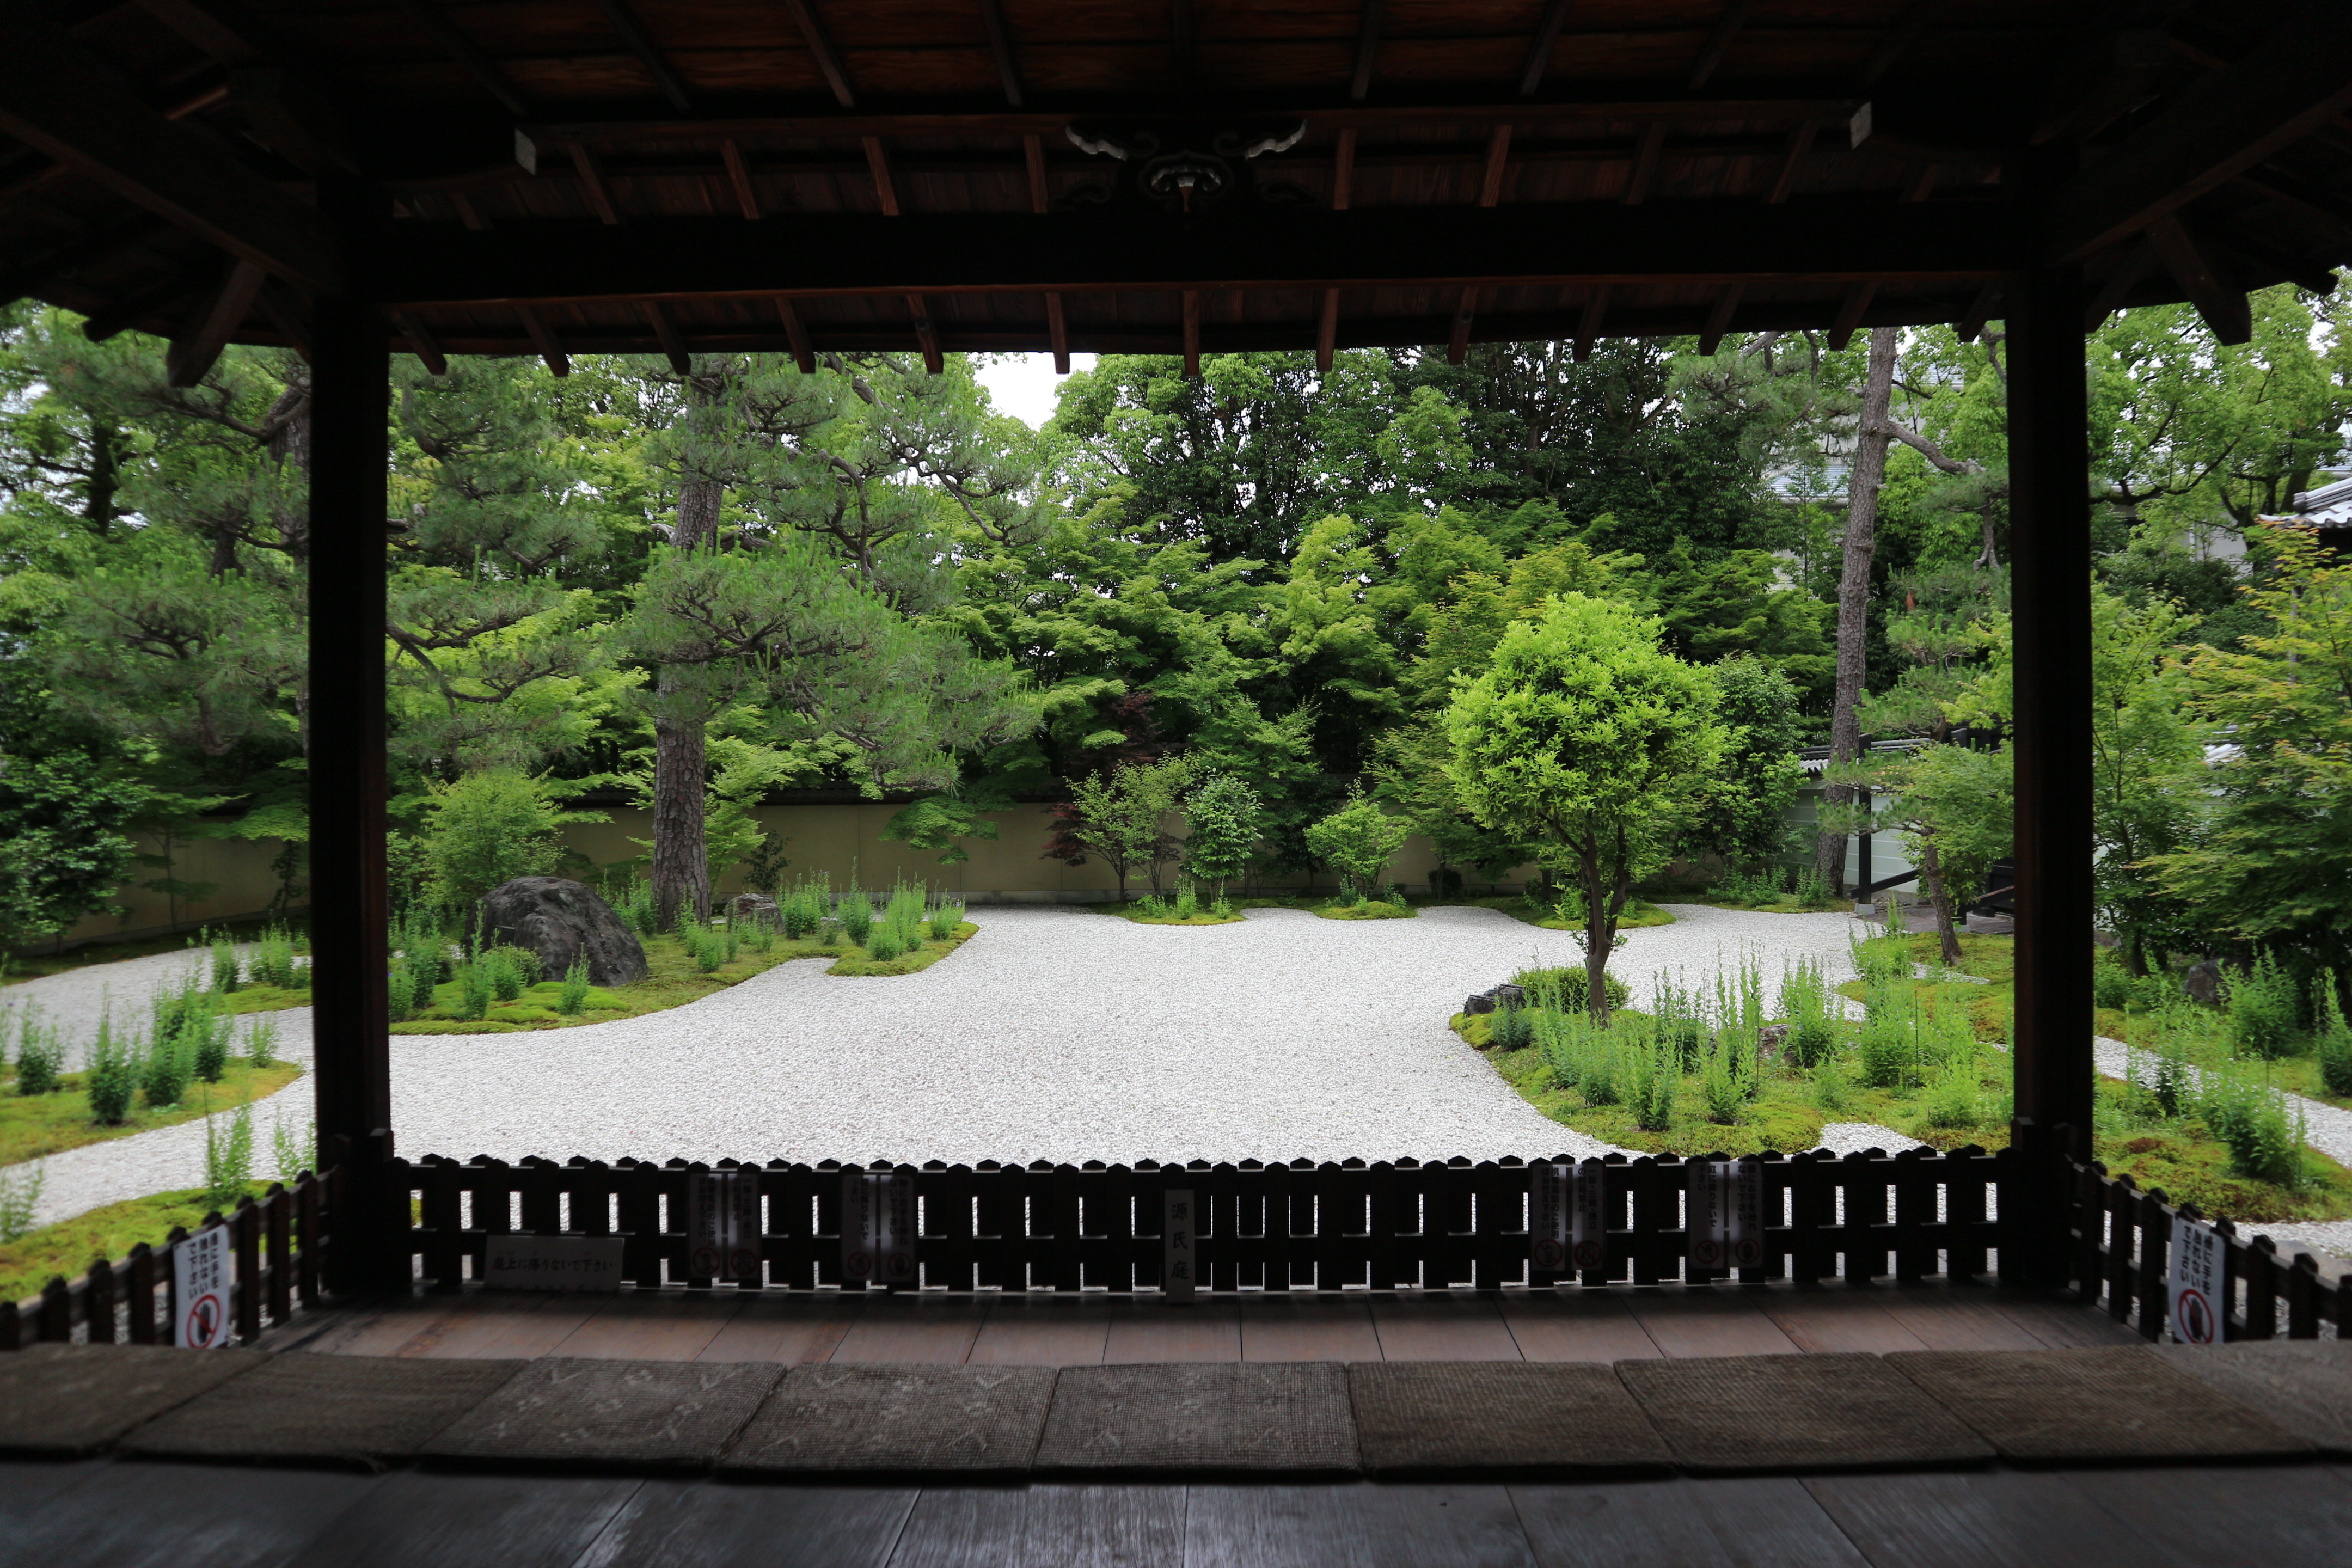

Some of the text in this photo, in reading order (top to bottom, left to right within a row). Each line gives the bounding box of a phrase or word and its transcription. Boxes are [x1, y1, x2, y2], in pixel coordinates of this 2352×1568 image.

[1542, 1168, 1550, 1229] はお控え下さい
[1551, 1168, 1559, 1239] 携帯電話のご使用
[1578, 1168, 1587, 1211] の利用禁止
[1698, 1166, 1706, 1191] 下さい
[1708, 1165, 1717, 1227] 庭に降りないで
[1738, 1165, 1747, 1221] ないで下さい
[890, 1179, 898, 1235] ないで下さい
[1171, 1203, 1189, 1279] 源氏庭
[2180, 1226, 2191, 1282] で下さい
[187, 1242, 197, 1299] で下さい
